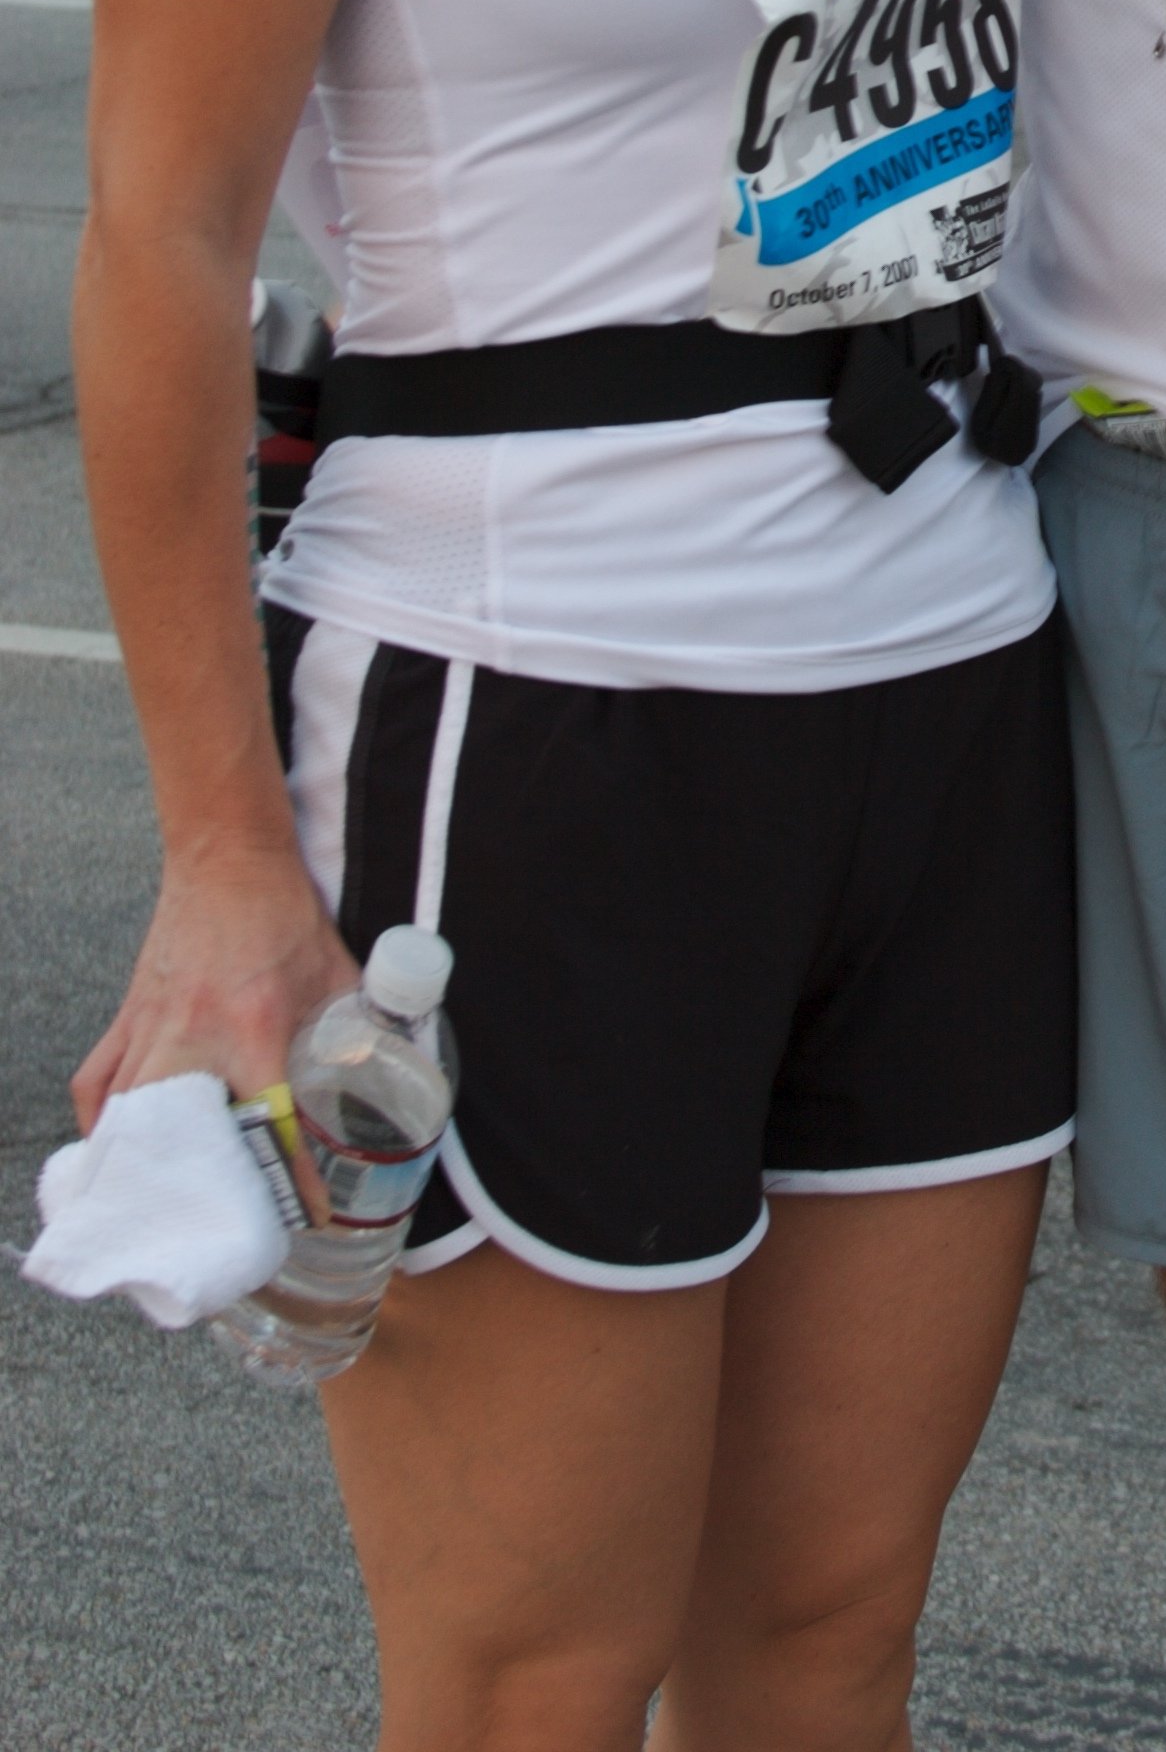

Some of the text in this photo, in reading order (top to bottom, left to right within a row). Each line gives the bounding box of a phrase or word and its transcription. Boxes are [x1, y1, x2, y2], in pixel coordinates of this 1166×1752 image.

[797, 183, 847, 239] 30th
[768, 279, 857, 310] October
[862, 269, 879, 294] 7,
[881, 253, 919, 288] 2007
